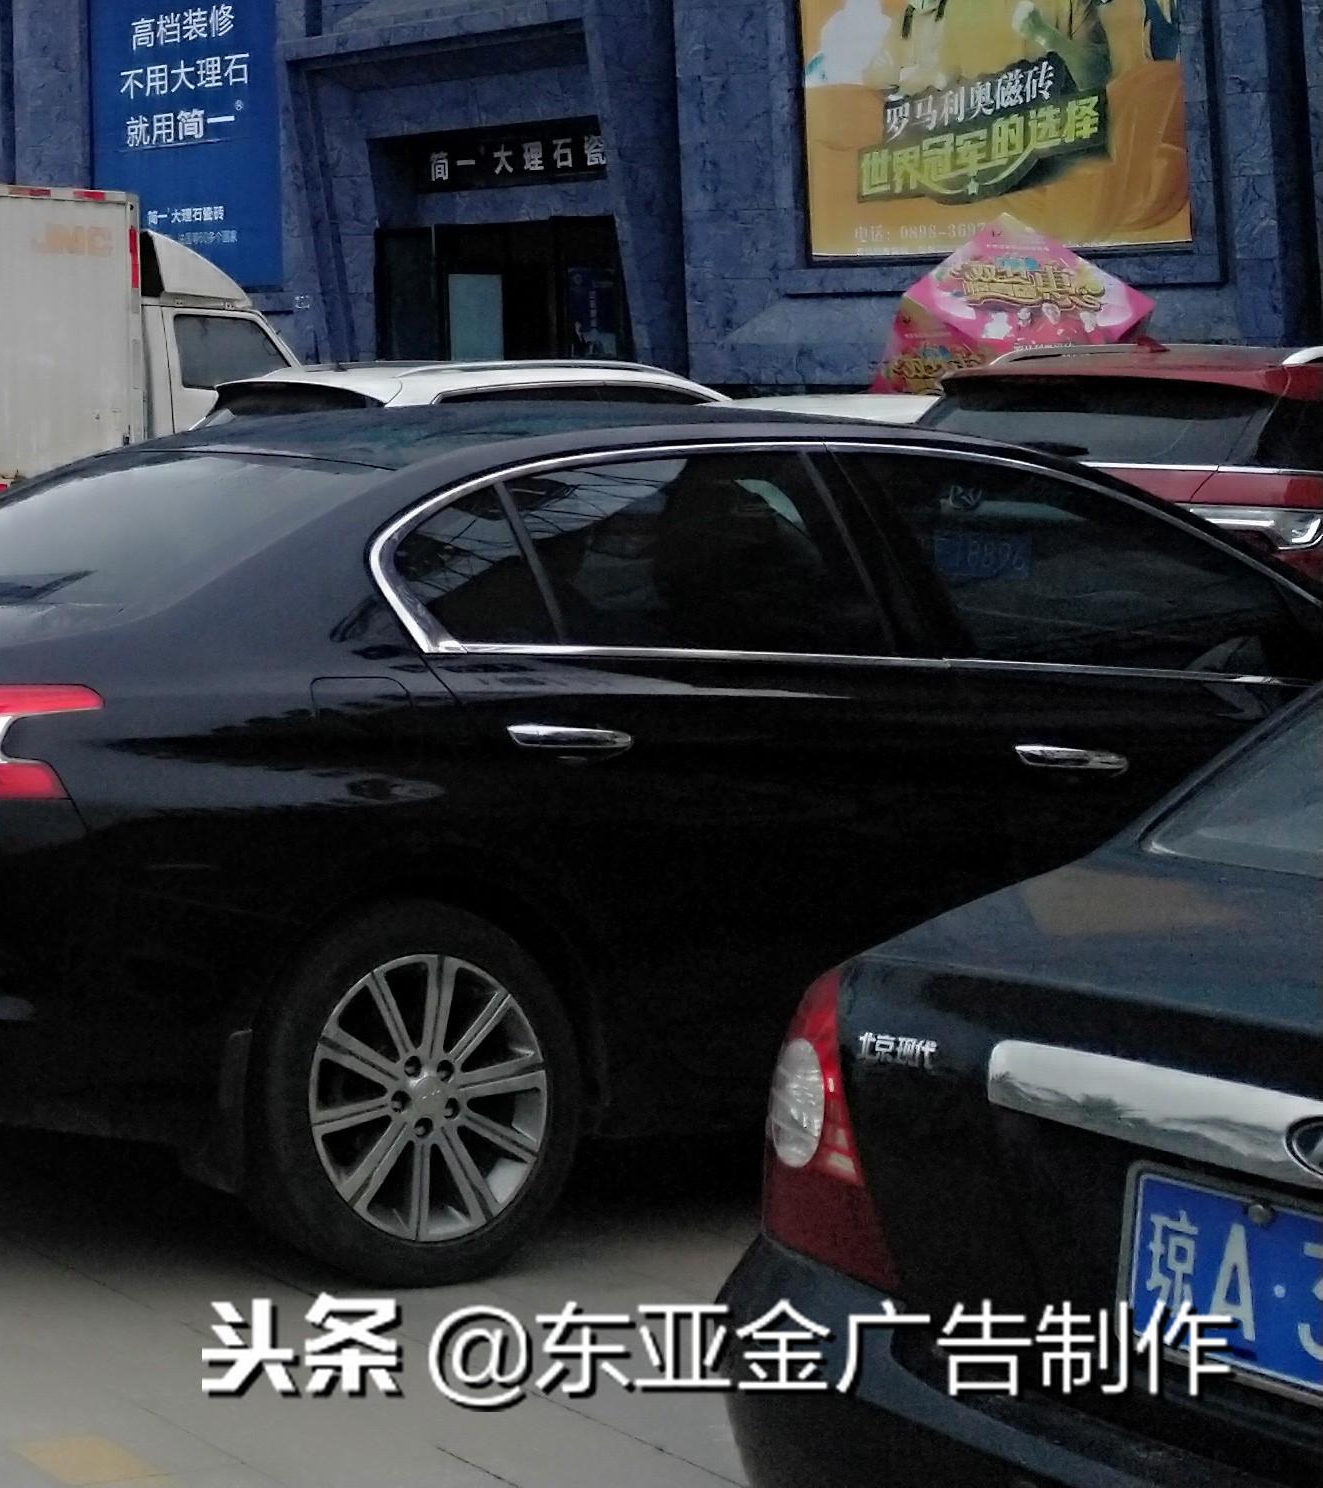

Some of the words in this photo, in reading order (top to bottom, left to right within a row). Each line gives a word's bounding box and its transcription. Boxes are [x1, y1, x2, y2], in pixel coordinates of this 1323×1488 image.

[131, 3, 235, 51] 高档装修
[120, 53, 251, 100] 不用大理石
[886, 61, 1056, 142] 罗马利奥磁砖
[126, 109, 236, 148] 就用简一
[860, 95, 1101, 198] 世界冠军的选择
[859, 1031, 939, 1071] 北京现代
